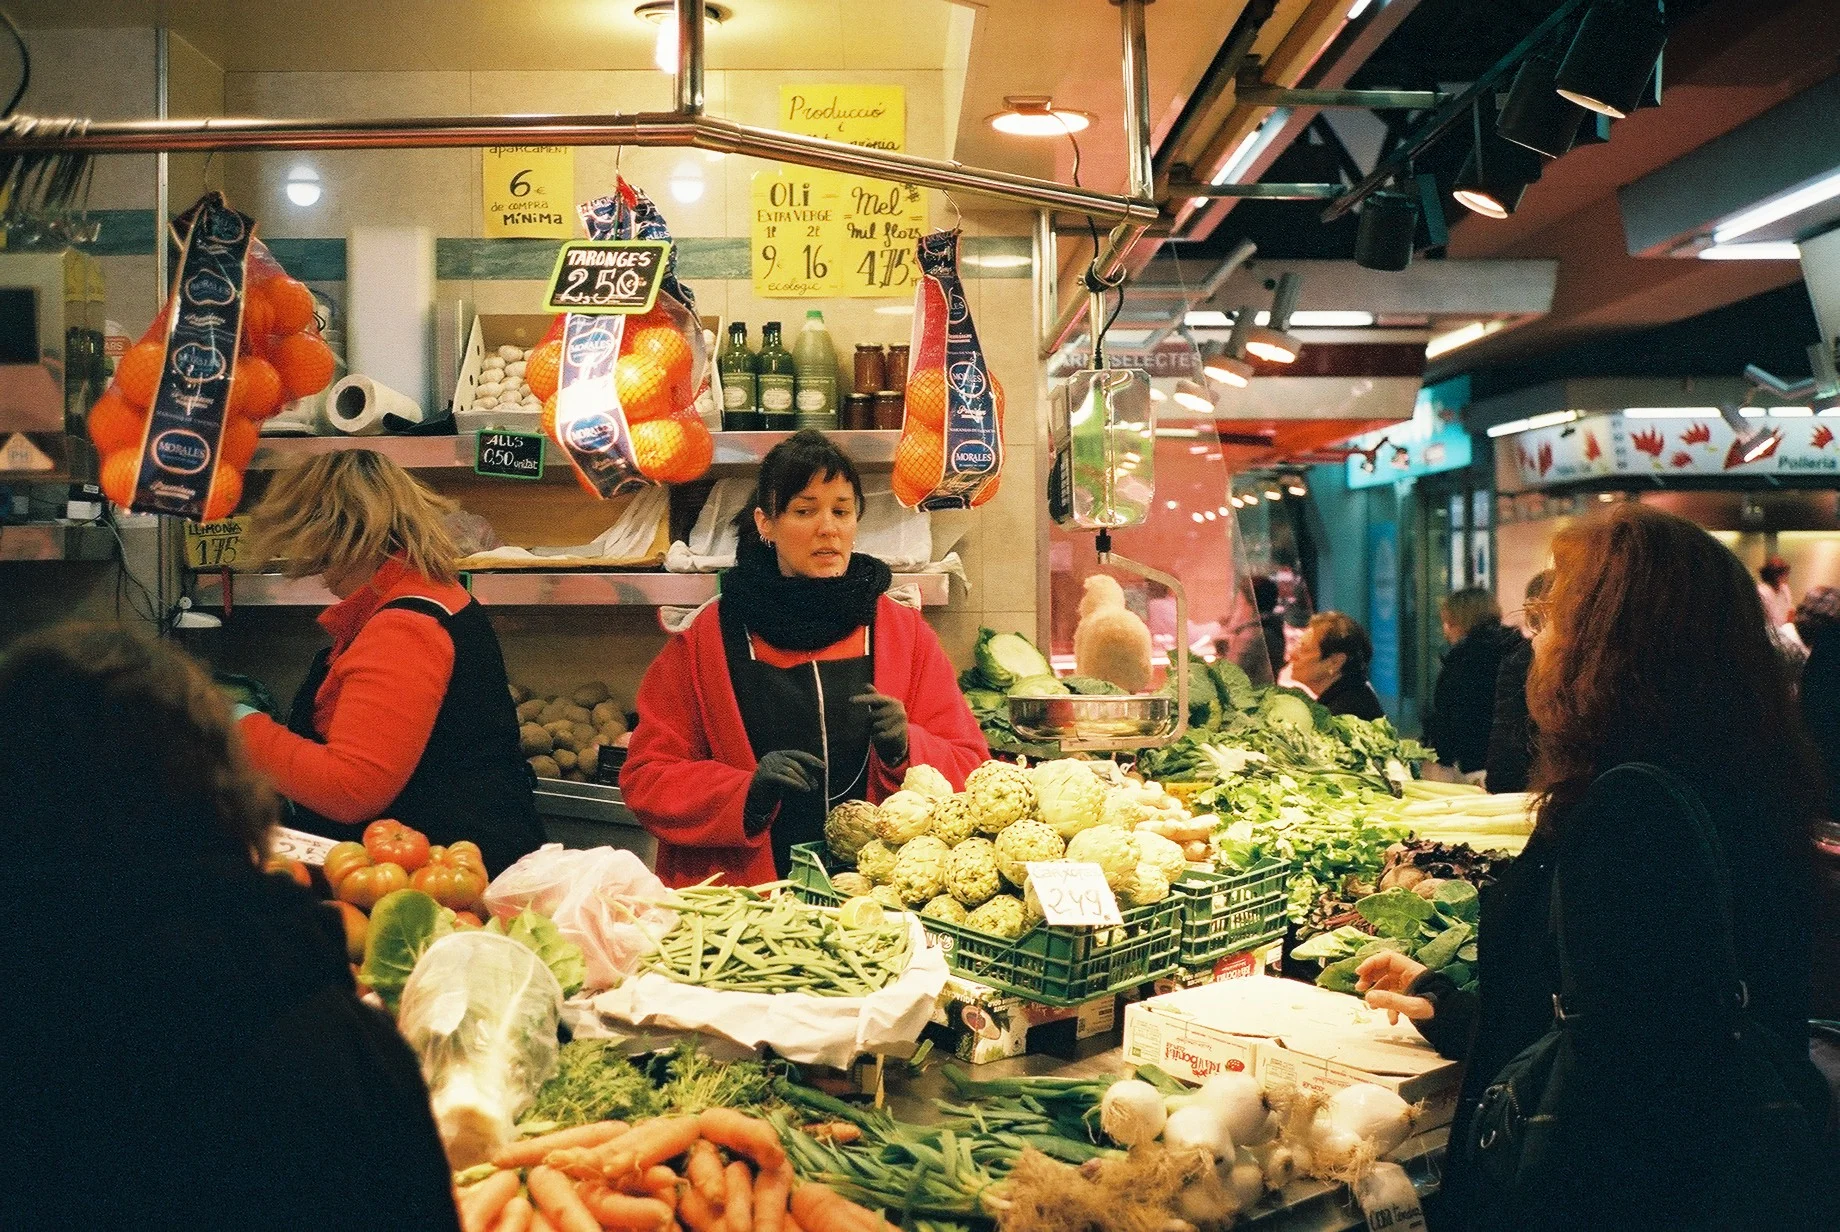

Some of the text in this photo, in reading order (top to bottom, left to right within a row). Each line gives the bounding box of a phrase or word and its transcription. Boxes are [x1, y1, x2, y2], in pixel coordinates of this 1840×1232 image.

[509, 169, 533, 198] 6
[851, 186, 903, 216] Mel
[567, 249, 653, 268] TARONGES
[802, 244, 828, 280] 16
[956, 452, 992, 464] MORALES
